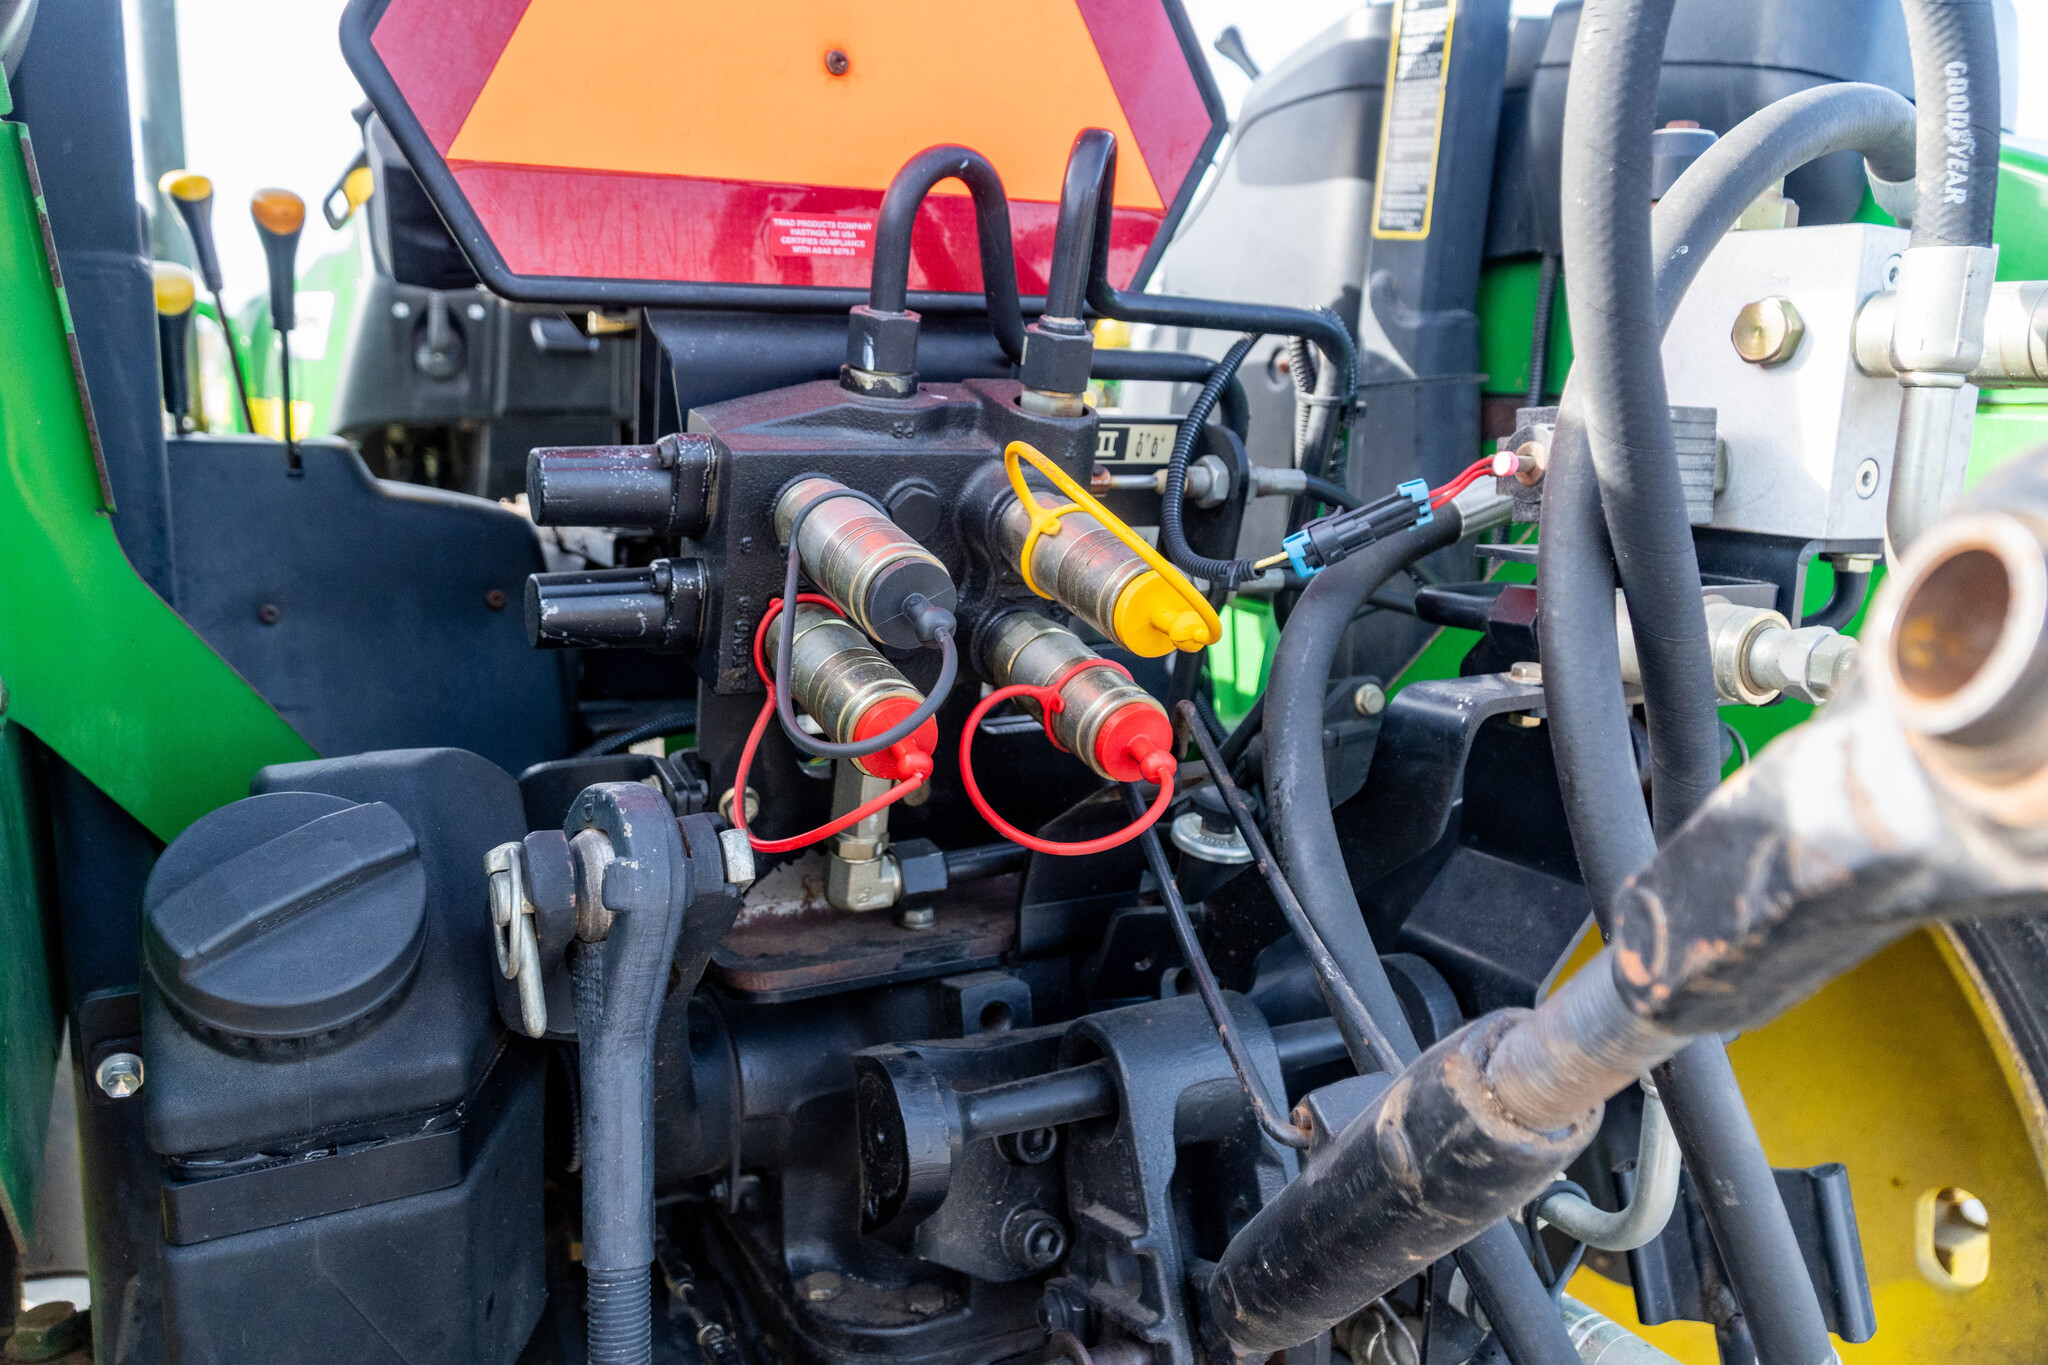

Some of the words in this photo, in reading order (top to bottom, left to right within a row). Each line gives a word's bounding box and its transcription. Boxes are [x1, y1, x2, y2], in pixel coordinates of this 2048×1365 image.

[1944, 61, 1971, 204] GOODYEAR
[773, 218, 795, 227] TRIAD
[796, 219, 836, 228] PRODUCTS
[837, 221, 872, 231] COMPANY
[790, 229, 829, 238] HASTINGS,
[829, 230, 840, 238] NE
[780, 236, 818, 245] CERTIFIES
[819, 238, 866, 247] COMPLIANCE
[792, 245, 811, 253] WITH
